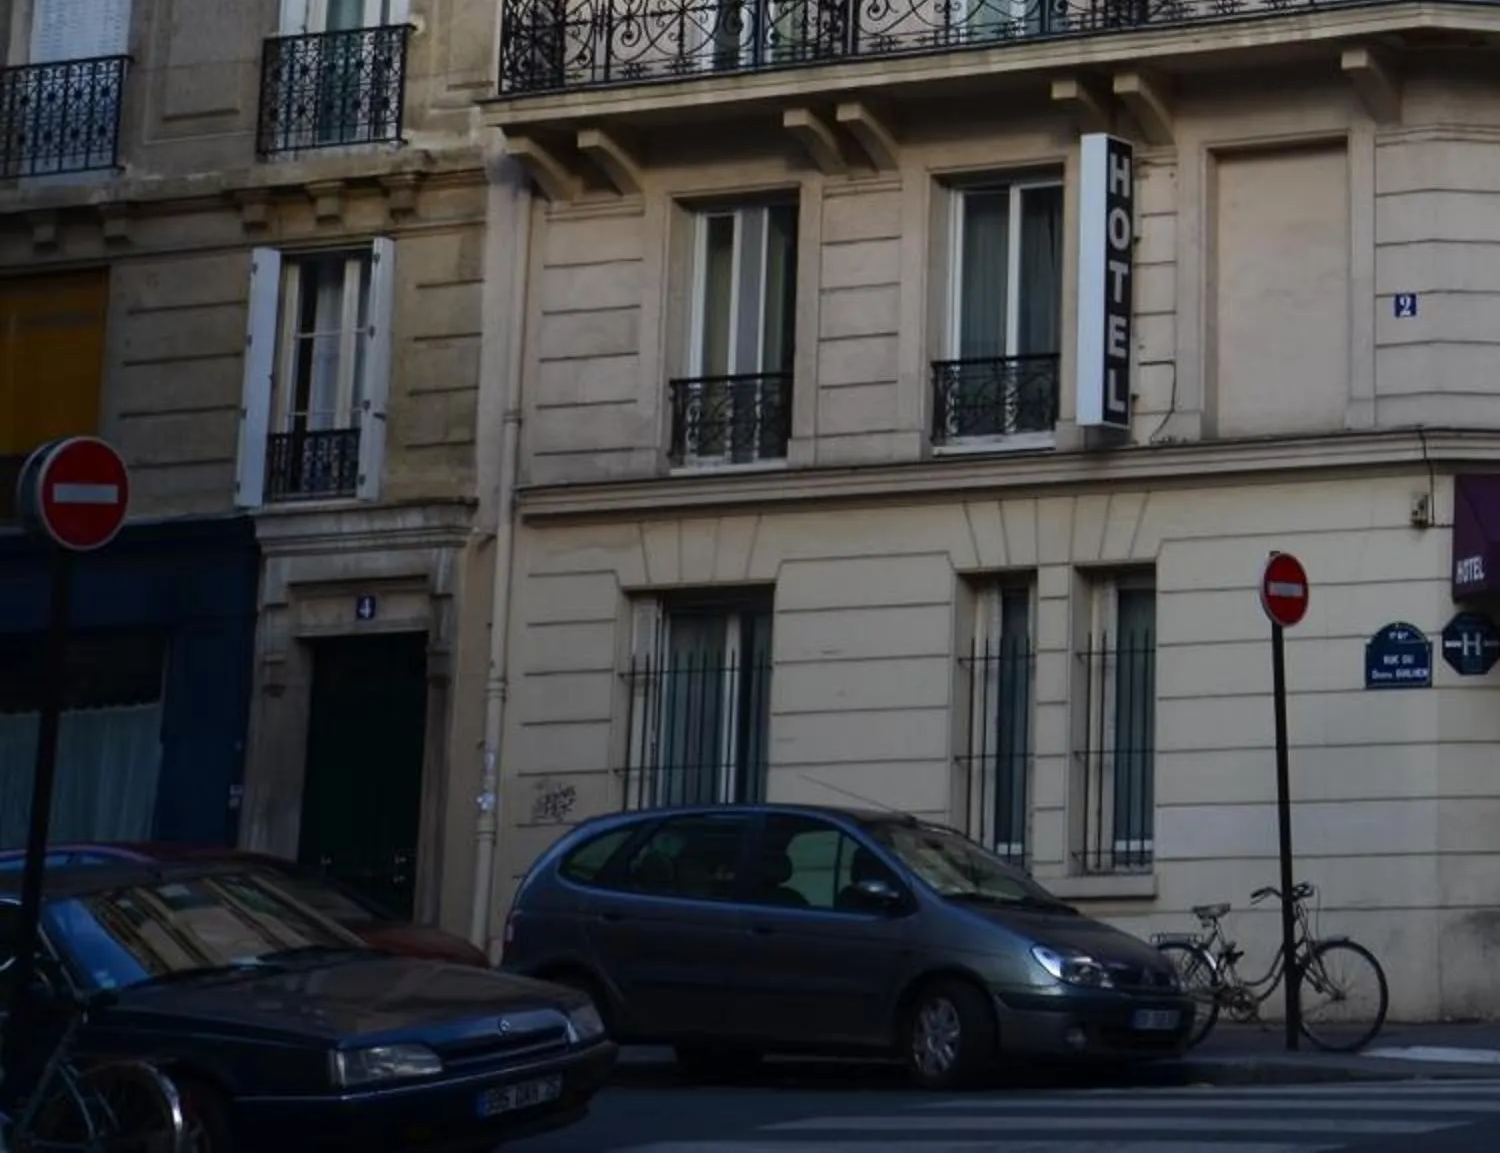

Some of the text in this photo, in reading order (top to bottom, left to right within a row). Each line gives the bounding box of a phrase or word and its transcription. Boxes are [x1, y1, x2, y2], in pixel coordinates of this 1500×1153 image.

[1107, 153, 1130, 413] HOTEL
[1399, 295, 1411, 316] 2
[1456, 555, 1485, 584] HOTEL
[359, 597, 372, 618] 4
[1462, 632, 1481, 656] H
[1383, 654, 1415, 665] RUE DU
